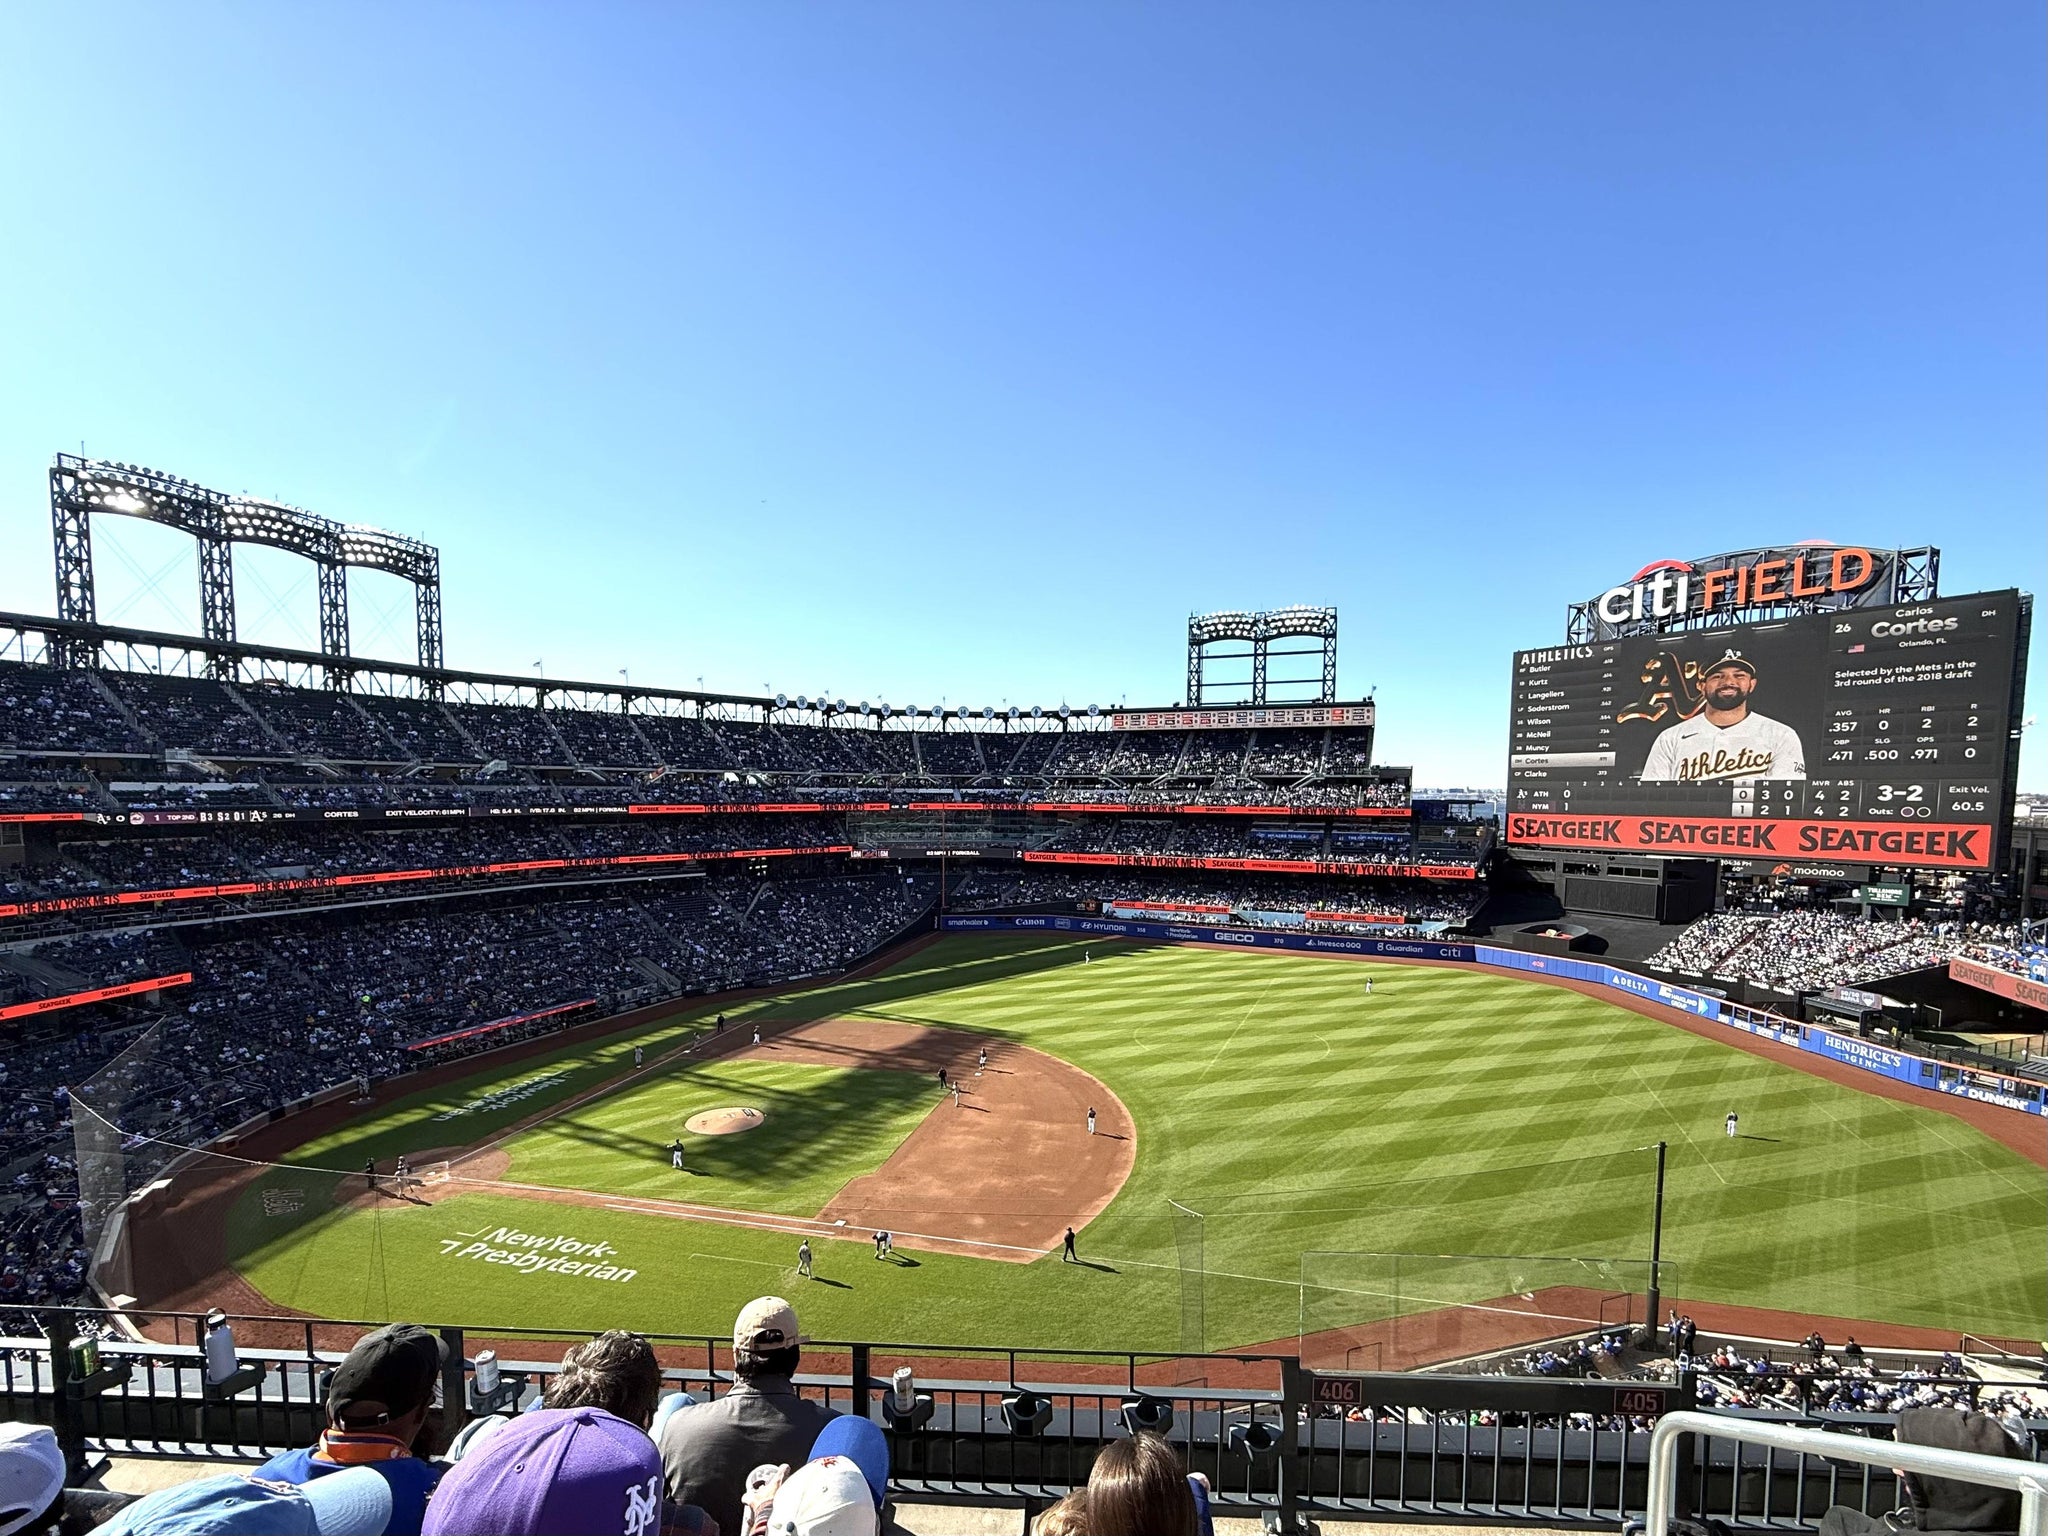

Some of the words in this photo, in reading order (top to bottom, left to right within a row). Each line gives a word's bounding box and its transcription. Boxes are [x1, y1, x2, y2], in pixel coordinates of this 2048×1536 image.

[1600, 569, 1688, 624] citi
[1704, 548, 1872, 610] FIELD
[1896, 607, 1933, 618] Carlos
[1982, 610, 1996, 618] DH
[1835, 624, 1852, 633] 26
[1871, 616, 1958, 638] Cortes
[1899, 640, 1934, 648] Orlando,
[1529, 665, 1551, 673] Butler
[1834, 668, 1878, 679] Selected
[1880, 667, 1893, 677] by
[1896, 666, 1912, 674] the
[1915, 664, 1941, 672] Mets
[1944, 662, 1954, 670] in
[1957, 660, 1976, 669] the
[1834, 679, 1850, 688] 3rd
[1852, 678, 1882, 686] round
[1884, 676, 1895, 684] of
[1898, 674, 1914, 682] the
[1917, 672, 1942, 682] 2018
[1944, 670, 1972, 680] draft
[1528, 703, 1570, 712] Soderstrom
[1828, 722, 1858, 732] .357
[1878, 720, 1888, 730] 0
[1922, 718, 1932, 728] 2
[1968, 716, 1978, 726] 2
[1526, 730, 1551, 738] McNeil
[1828, 751, 1852, 761] .471
[1864, 750, 1898, 760] .500
[1910, 749, 1938, 759] .971
[1964, 748, 1976, 758] 0
[1679, 747, 1772, 780] Athletics
[1564, 790, 1570, 798] 0
[1740, 790, 1748, 800] 0
[1761, 790, 1770, 800] 3
[1784, 790, 1794, 800] 0
[1815, 790, 1825, 800] 4
[1840, 790, 1850, 800] 2
[1878, 785, 1923, 802] 3-2
[1949, 786, 1968, 794] Exit
[1289, 807, 1301, 815] THE
[1318, 808, 1337, 816] YORK
[1338, 808, 1357, 816] METS
[1760, 806, 1769, 816] 2
[1814, 806, 1824, 817] 4
[1838, 806, 1849, 817] 2
[1868, 808, 1894, 816] Outs:
[1952, 802, 1984, 812] 60.5
[1512, 817, 1622, 844] SEATGEEK
[1638, 820, 1777, 850] SEATGEEK
[1799, 825, 1979, 861] SEATGEEK
[1116, 855, 1132, 866] THE
[1133, 856, 1154, 866] NEW
[1156, 856, 1180, 868] YORK
[1180, 857, 1206, 868] METS
[1212, 860, 1246, 868] SEATGEEK
[1315, 863, 1334, 874] THE
[1334, 864, 1358, 875] NEW
[1360, 864, 1389, 876] YORK
[1392, 866, 1422, 877] METS
[1429, 868, 1469, 877] SEATGEEK
[1794, 867, 1845, 877] moomoo
[256, 882, 272, 892] THE
[272, 880, 291, 892] NEW
[292, 879, 314, 890] YORK
[314, 878, 337, 888] METS
[16, 903, 37, 916] THE
[38, 900, 62, 914] NEW
[62, 896, 92, 911] YORK
[92, 894, 120, 908] METS
[140, 890, 176, 900] SEATGEEK
[1016, 918, 1045, 926] Canon
[1094, 924, 1126, 932] HYUNDAI
[1214, 932, 1254, 942] GEICO
[1318, 940, 1345, 948] Invesco
[1386, 944, 1423, 953] Guardian
[1440, 948, 1461, 958] citi
[1954, 964, 1995, 990] SEATGEEK
[1620, 978, 1648, 992] DELTA
[102, 986, 130, 997] SEATGEEK
[1825, 1036, 1902, 1067] HENDRICK'S
[1850, 1056, 1872, 1068] GIN
[1968, 1088, 2028, 1111] DUNKIN'
[484, 1227, 618, 1258] NewYork-
[456, 1242, 638, 1282] Presbyterian
[1320, 1386, 1355, 1400] 406
[1621, 1394, 1658, 1412] 405
